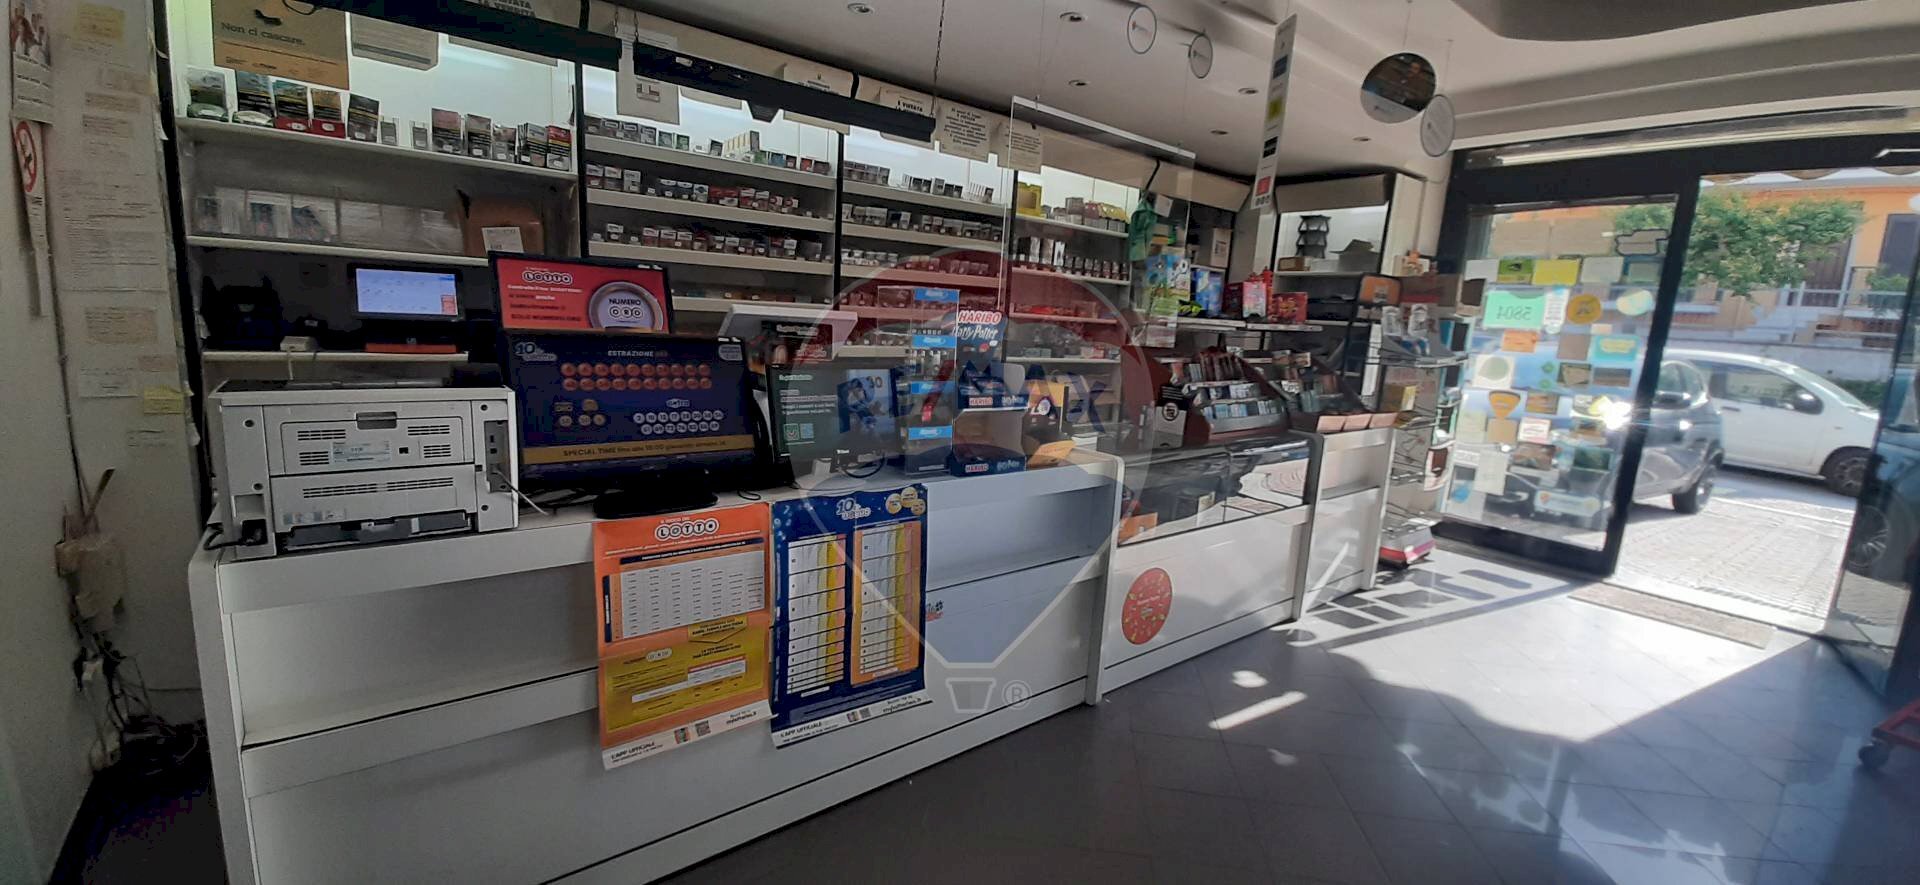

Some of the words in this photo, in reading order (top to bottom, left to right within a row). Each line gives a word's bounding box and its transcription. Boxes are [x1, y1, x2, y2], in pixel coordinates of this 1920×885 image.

[221, 22, 245, 34] Non
[248, 27, 258, 36] ci
[260, 31, 305, 45] cascare.
[523, 271, 573, 285] LOTTO
[608, 297, 642, 306] NUMERO
[609, 306, 643, 318] ORO
[958, 310, 1001, 324] HARIBO
[952, 325, 974, 340] Harry
[973, 325, 998, 340] Potter
[969, 397, 993, 406] HARIBO
[965, 463, 989, 473] HARIBO
[836, 497, 856, 516] 10
[655, 518, 720, 541] LOTTO
